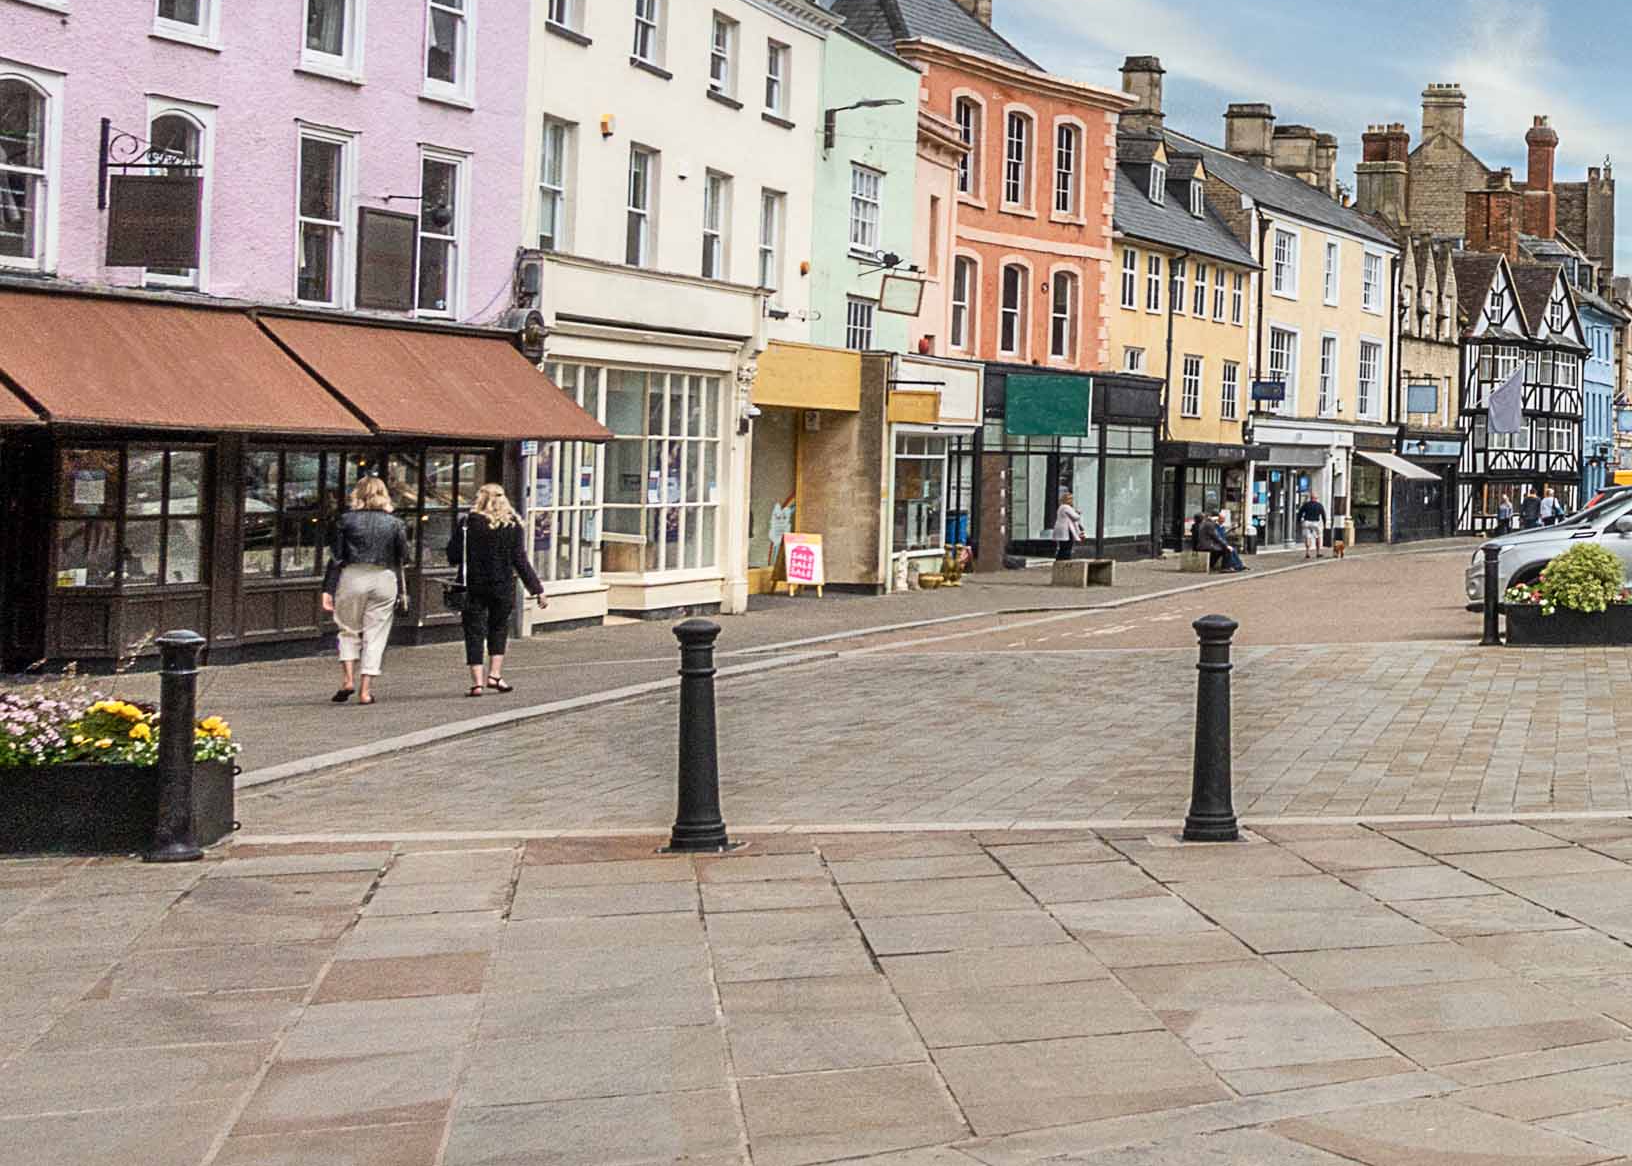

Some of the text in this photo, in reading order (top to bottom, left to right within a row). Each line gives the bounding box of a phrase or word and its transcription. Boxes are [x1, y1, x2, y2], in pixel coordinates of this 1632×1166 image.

[791, 552, 814, 562] SALE
[791, 560, 813, 570] SALE
[790, 568, 812, 578] SALE
